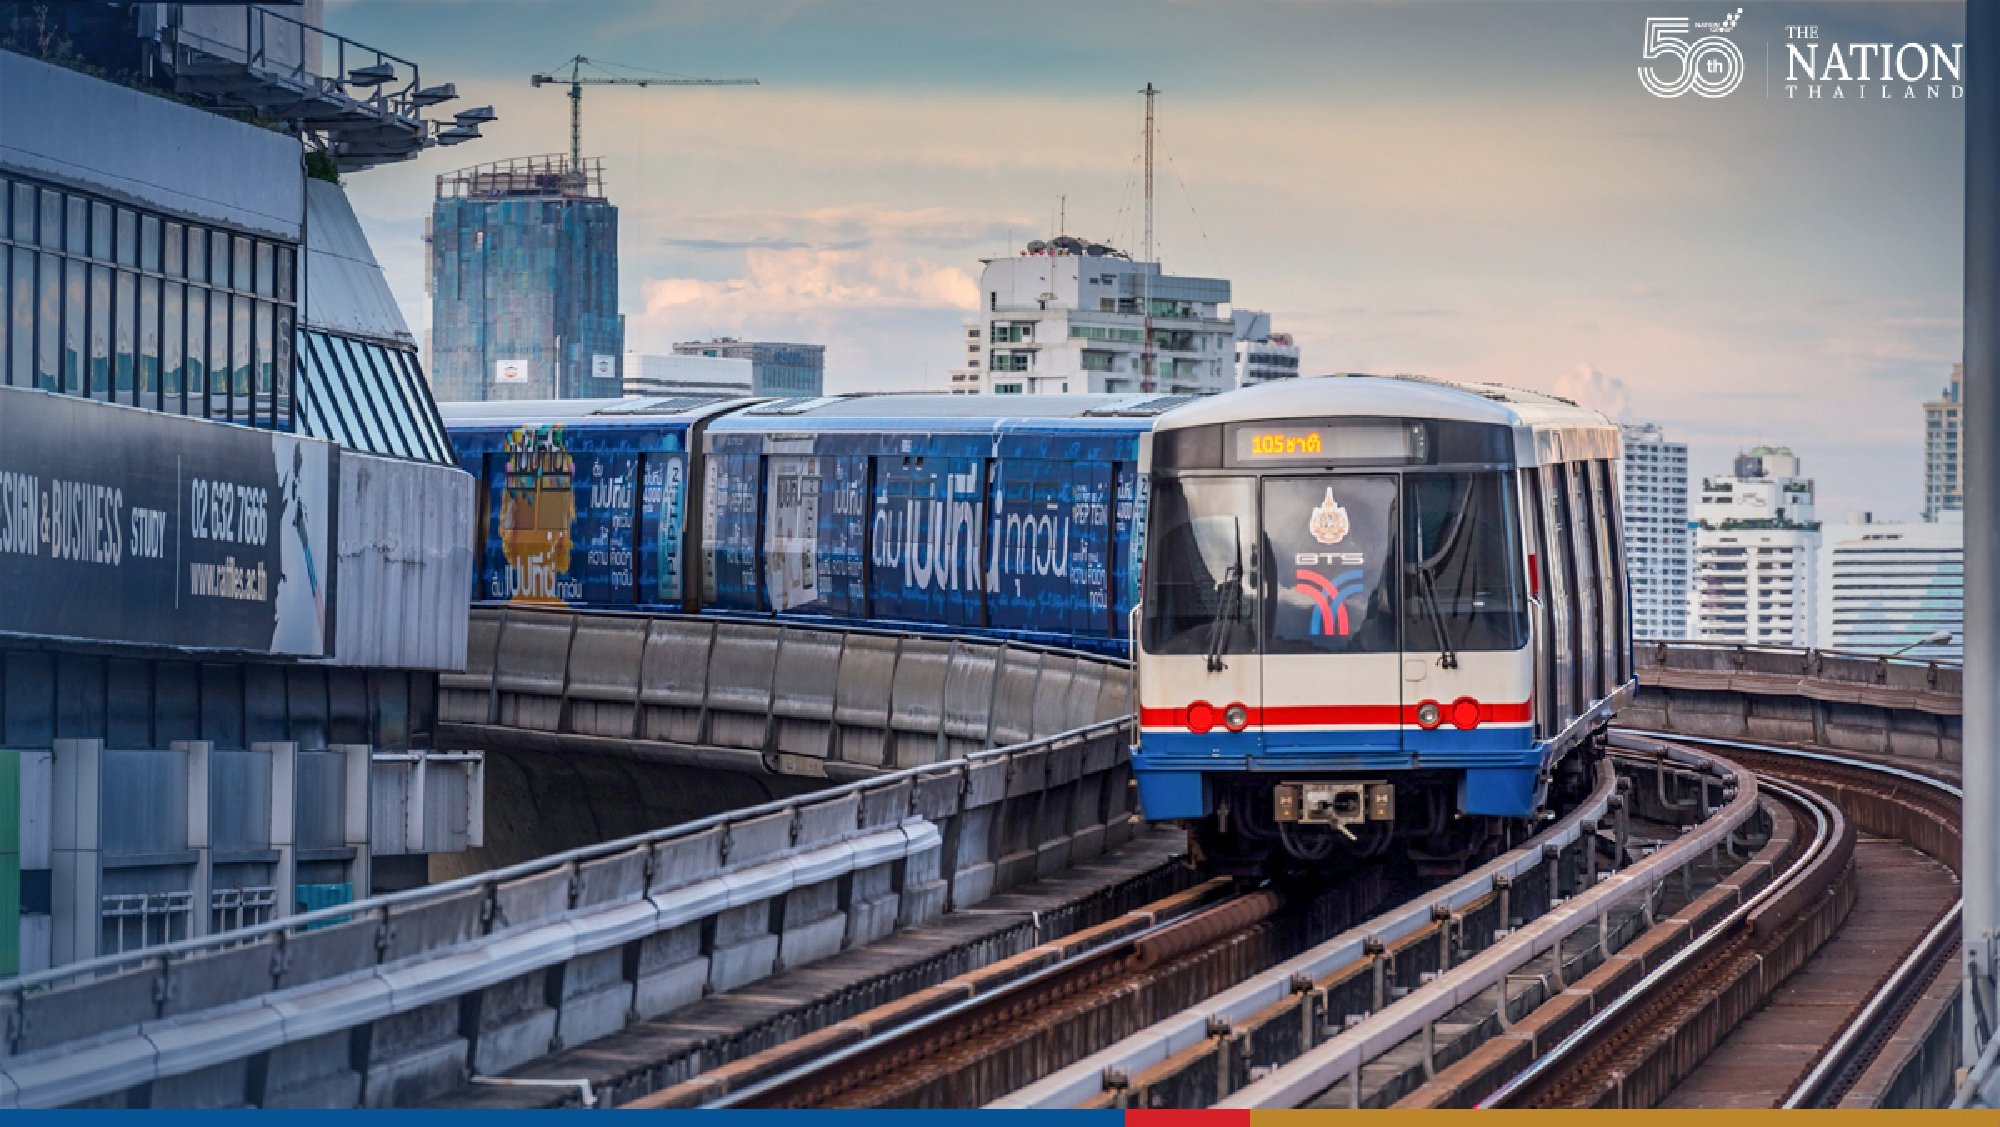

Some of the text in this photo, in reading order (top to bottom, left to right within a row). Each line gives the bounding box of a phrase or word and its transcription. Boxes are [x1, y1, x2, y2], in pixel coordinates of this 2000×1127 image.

[41, 491, 51, 543] &
[51, 478, 122, 567] BUSINESS
[130, 506, 167, 559] STUDY
[191, 477, 268, 547] 02 632 7666
[1295, 552, 1365, 565] BTS
